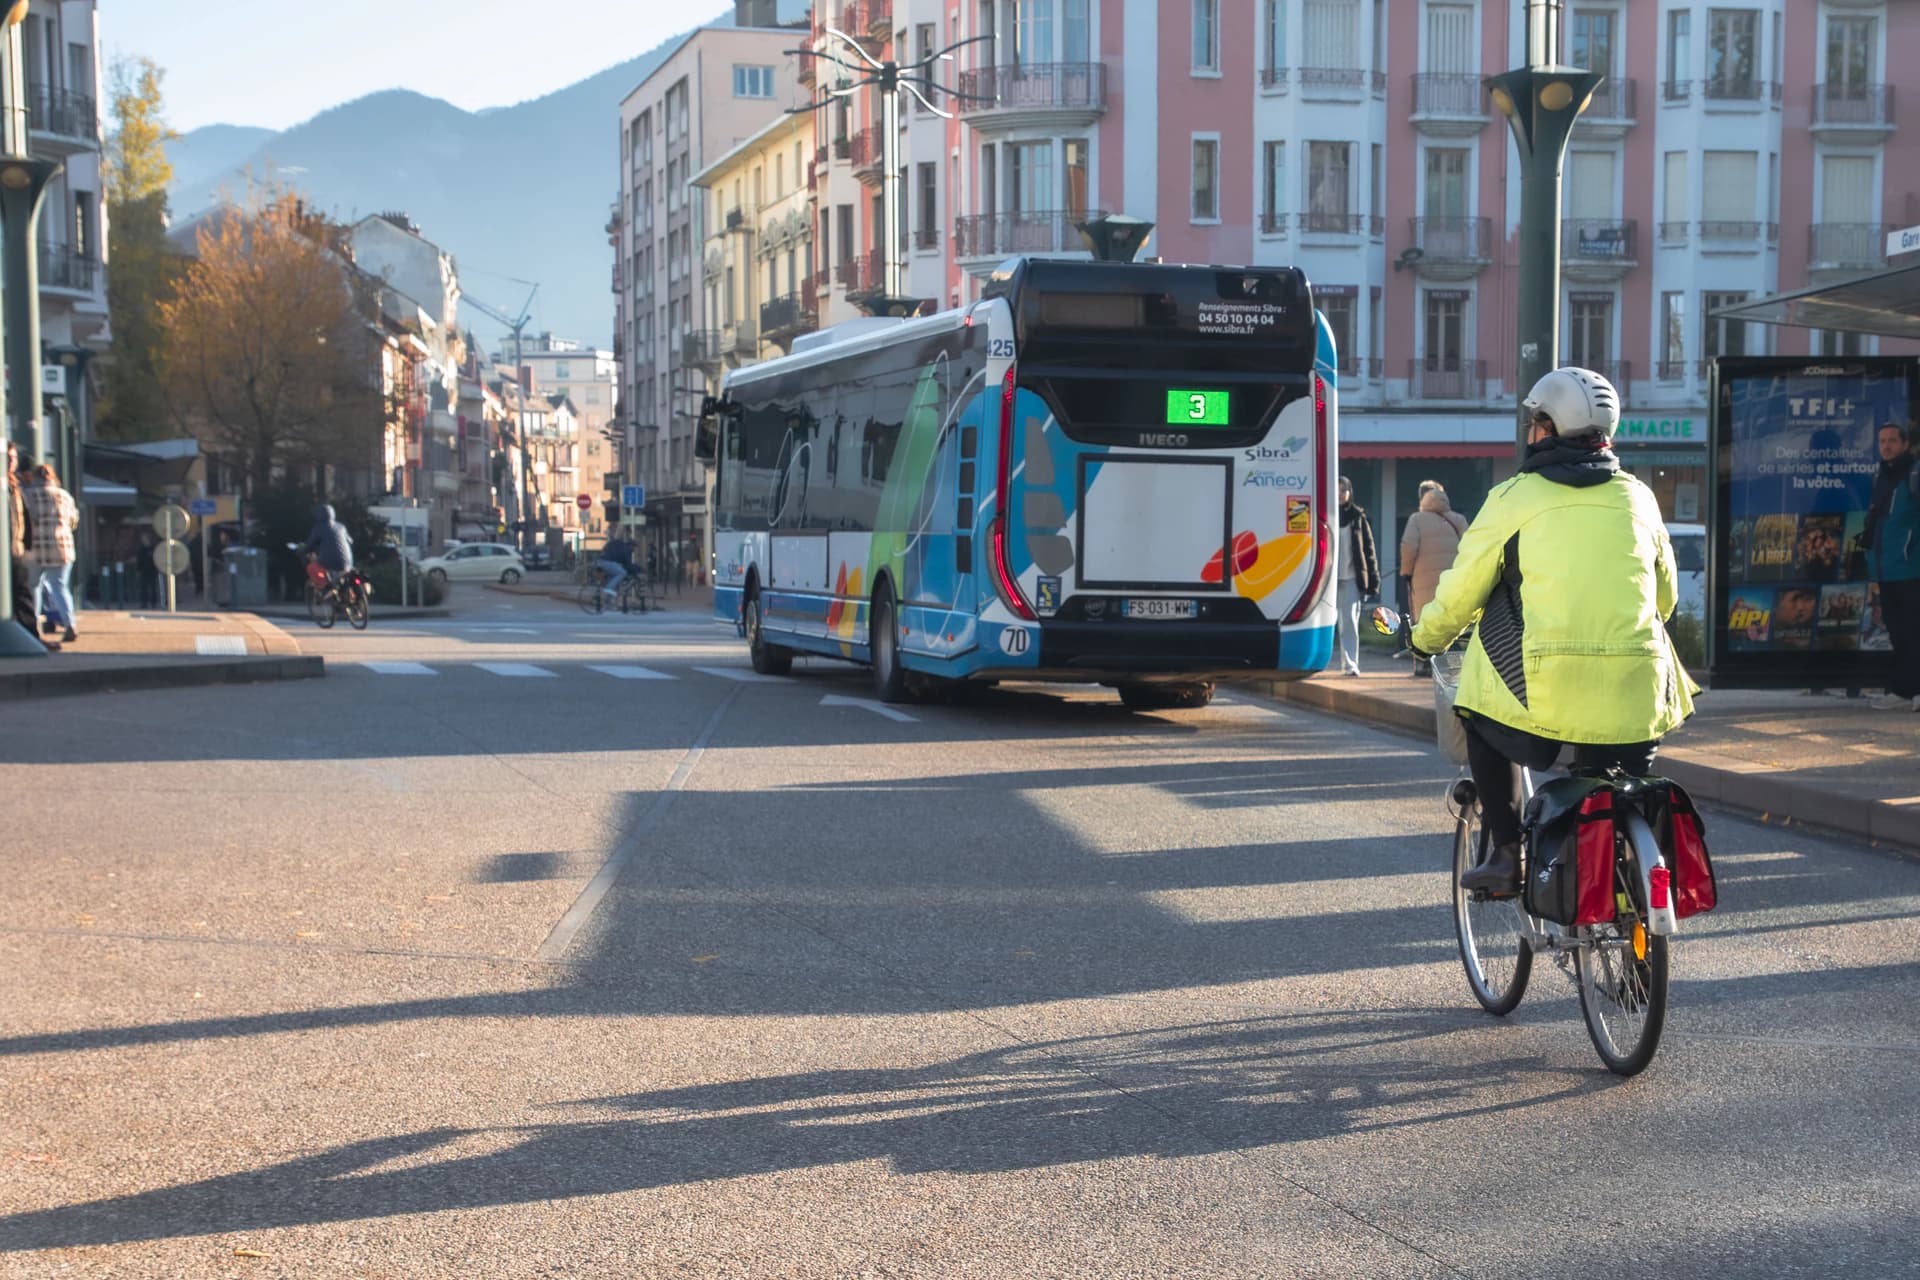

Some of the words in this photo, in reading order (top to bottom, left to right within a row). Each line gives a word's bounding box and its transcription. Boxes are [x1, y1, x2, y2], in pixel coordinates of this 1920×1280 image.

[1199, 302, 1261, 313] Renseignements
[1263, 304, 1282, 313] Sibra
[1199, 313, 1213, 323] 04
[1215, 313, 1229, 324] 50
[1230, 314, 1242, 324] 10
[1245, 314, 1259, 325] 04
[1260, 315, 1274, 325] 04
[1199, 325, 1255, 335] www.sibra.fr
[1189, 394, 1206, 419] 3
[1139, 433, 1188, 447] IVECO
[1244, 447, 1290, 461] Sibra
[1775, 446, 1800, 458] Des
[1803, 446, 1864, 458] centaines
[1758, 463, 1775, 474] de
[1816, 463, 1831, 474] et
[1242, 470, 1308, 490] Annecy
[1793, 477, 1805, 489] la
[1806, 476, 1846, 489] vôtre.
[1729, 610, 1770, 629] HPI
[1004, 628, 1026, 653] 70
